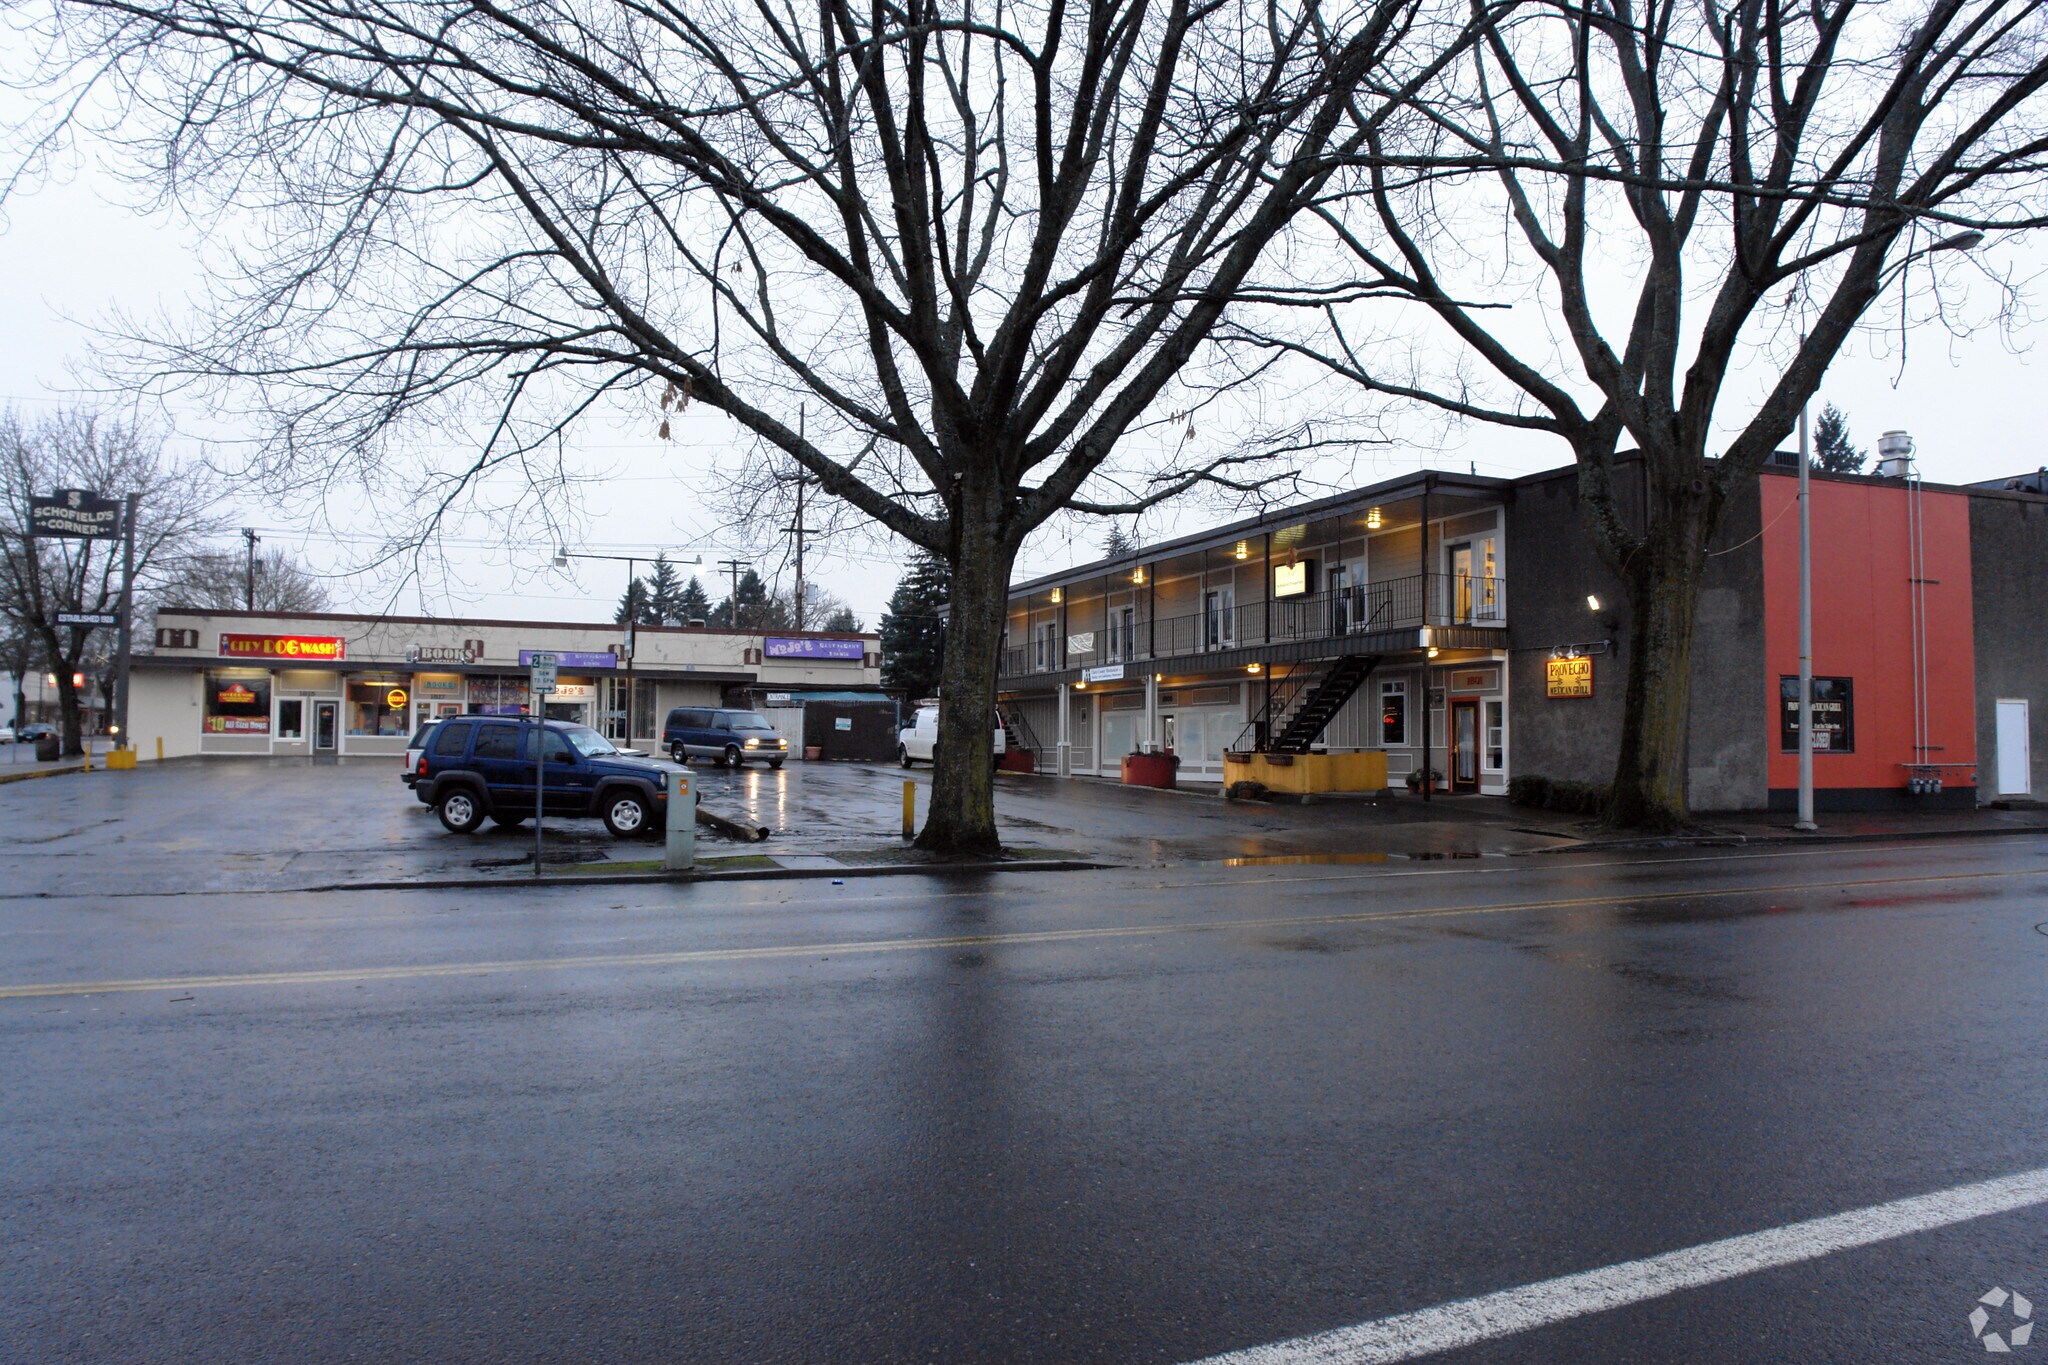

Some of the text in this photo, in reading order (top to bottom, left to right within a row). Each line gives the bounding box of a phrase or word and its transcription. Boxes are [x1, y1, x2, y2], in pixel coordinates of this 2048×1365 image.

[33, 506, 114, 522] SCHOFIELD'S
[47, 519, 98, 535] CORNER
[58, 613, 100, 623] ESTABLISHED
[230, 640, 335, 655] CITY DOG WASH
[421, 648, 473, 660] BOOKS
[533, 656, 539, 667] 2
[1550, 662, 1589, 677] PROVECHO
[555, 686, 585, 695] ojo's
[1550, 685, 1589, 695] MEXICAN GRILL
